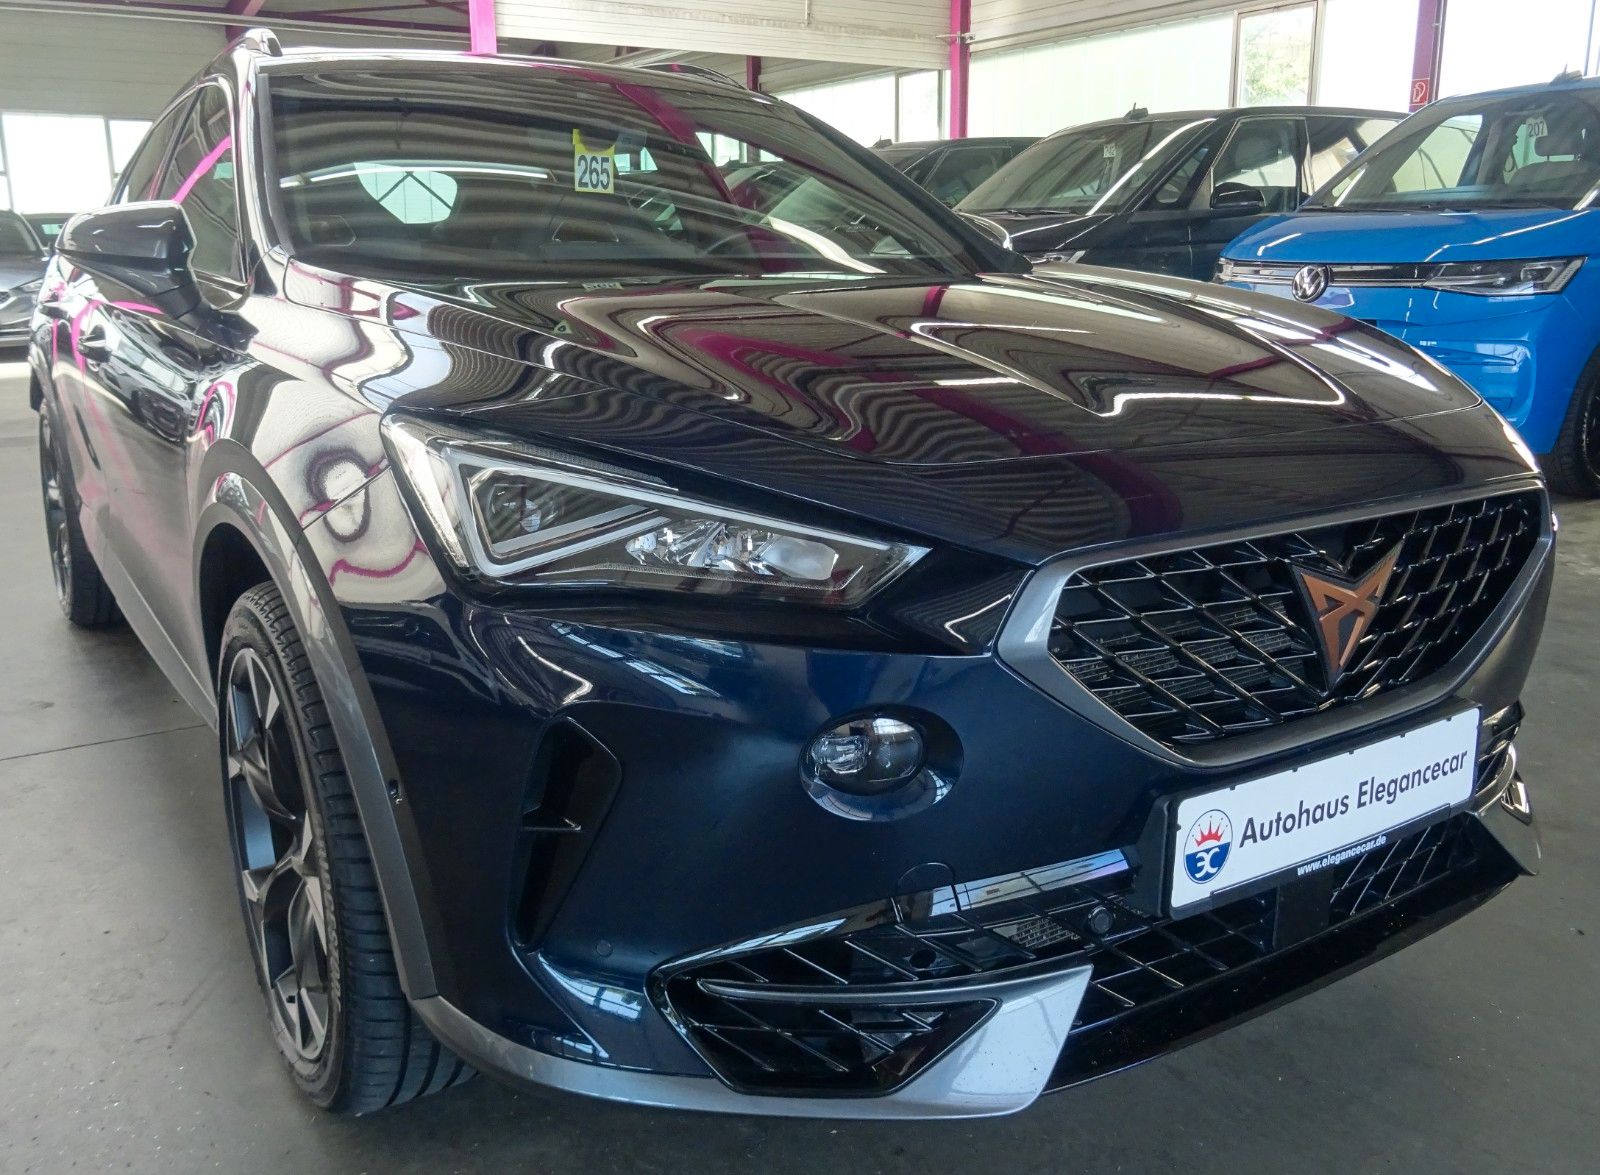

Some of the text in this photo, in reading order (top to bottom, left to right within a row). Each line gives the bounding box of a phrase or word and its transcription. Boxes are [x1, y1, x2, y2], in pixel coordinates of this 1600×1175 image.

[1527, 120, 1545, 138] 207
[577, 154, 611, 190] 265
[1239, 750, 1468, 849] Autohaus Elegancecar
[1296, 833, 1388, 876] www.elegancecar.de
